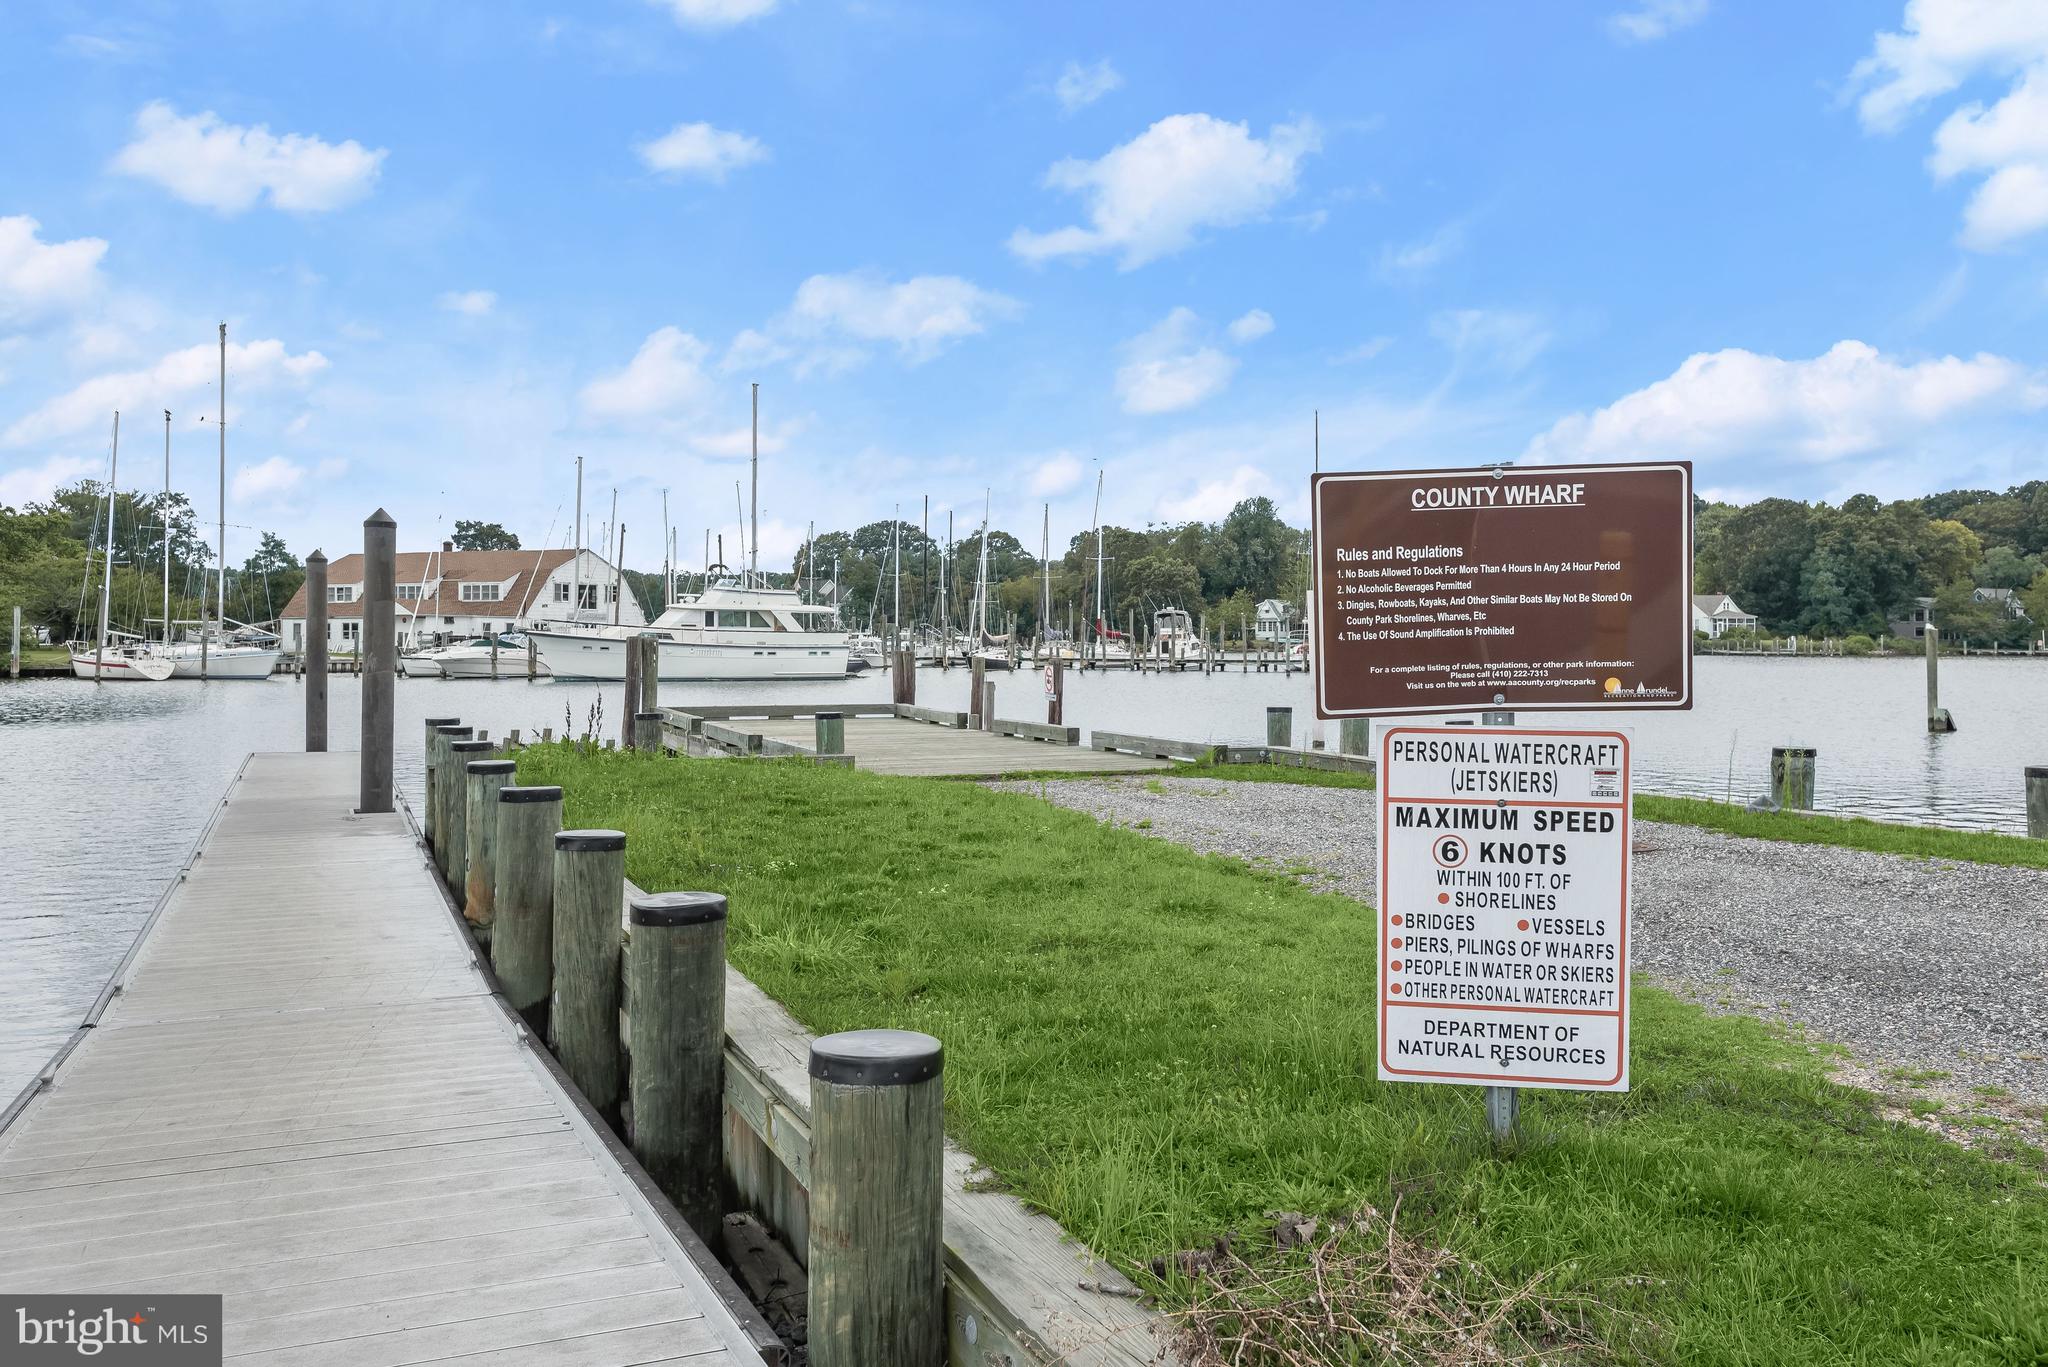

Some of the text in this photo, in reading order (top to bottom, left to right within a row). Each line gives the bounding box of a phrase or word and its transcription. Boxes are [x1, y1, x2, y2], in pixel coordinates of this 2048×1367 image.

[1411, 484, 1584, 508] COUNTY WHARF
[1337, 545, 1463, 561] Rules and Regulations
[1337, 570, 1344, 578] 1.
[1346, 569, 1356, 578] No
[1358, 568, 1379, 578] Boats
[1381, 567, 1411, 577] Allowed
[1413, 567, 1422, 575] To
[1424, 566, 1443, 575] Dock
[1445, 566, 1457, 574] For
[1459, 565, 1478, 574] More
[1480, 564, 1499, 573] Than
[1509, 563, 1532, 572] Hours
[1534, 563, 1542, 571] In
[1544, 563, 1559, 574] Any
[1561, 562, 1570, 571] 24
[1573, 562, 1592, 571] Hour
[1594, 561, 1620, 570] Period
[1337, 581, 1471, 594] 2. No Alcoholic Beverages Permitted
[1338, 593, 1632, 611] 3. Dingies, Rowboats, Kayaks, And Other Similar Boats May Not Be Stored On
[1347, 611, 1486, 626] County Park Shorelines, Wharves, Etc
[1338, 626, 1514, 640] 4. The Use Of Sound Amplification Is Prohibited
[1487, 678, 1596, 686] www.aacounty.org/recparks
[1393, 741, 1618, 766] PERSONAL WATERCRAFT
[1451, 768, 1558, 797] (JETSKIERS)
[1396, 807, 1615, 833] MAXIMUM SPEED
[1442, 841, 1567, 865] 6 KNOTS
[1437, 870, 1571, 890] WITHIN 100 FT. OF
[1455, 892, 1557, 911] SHORELINES
[1405, 913, 1475, 931] BRIDGES
[1532, 918, 1605, 936] VESSELS
[1405, 937, 1615, 960] PIERS, PILINGS OF WHARFS
[1405, 959, 1614, 984] PEOPLE IN WATER OR SKIERS
[1404, 982, 1614, 1007] OTHER PERSONAL WATERCRAFT
[1424, 1020, 1580, 1043] DEPARTMENT OF
[1399, 1040, 1606, 1065] NATURAL RESOURCES
